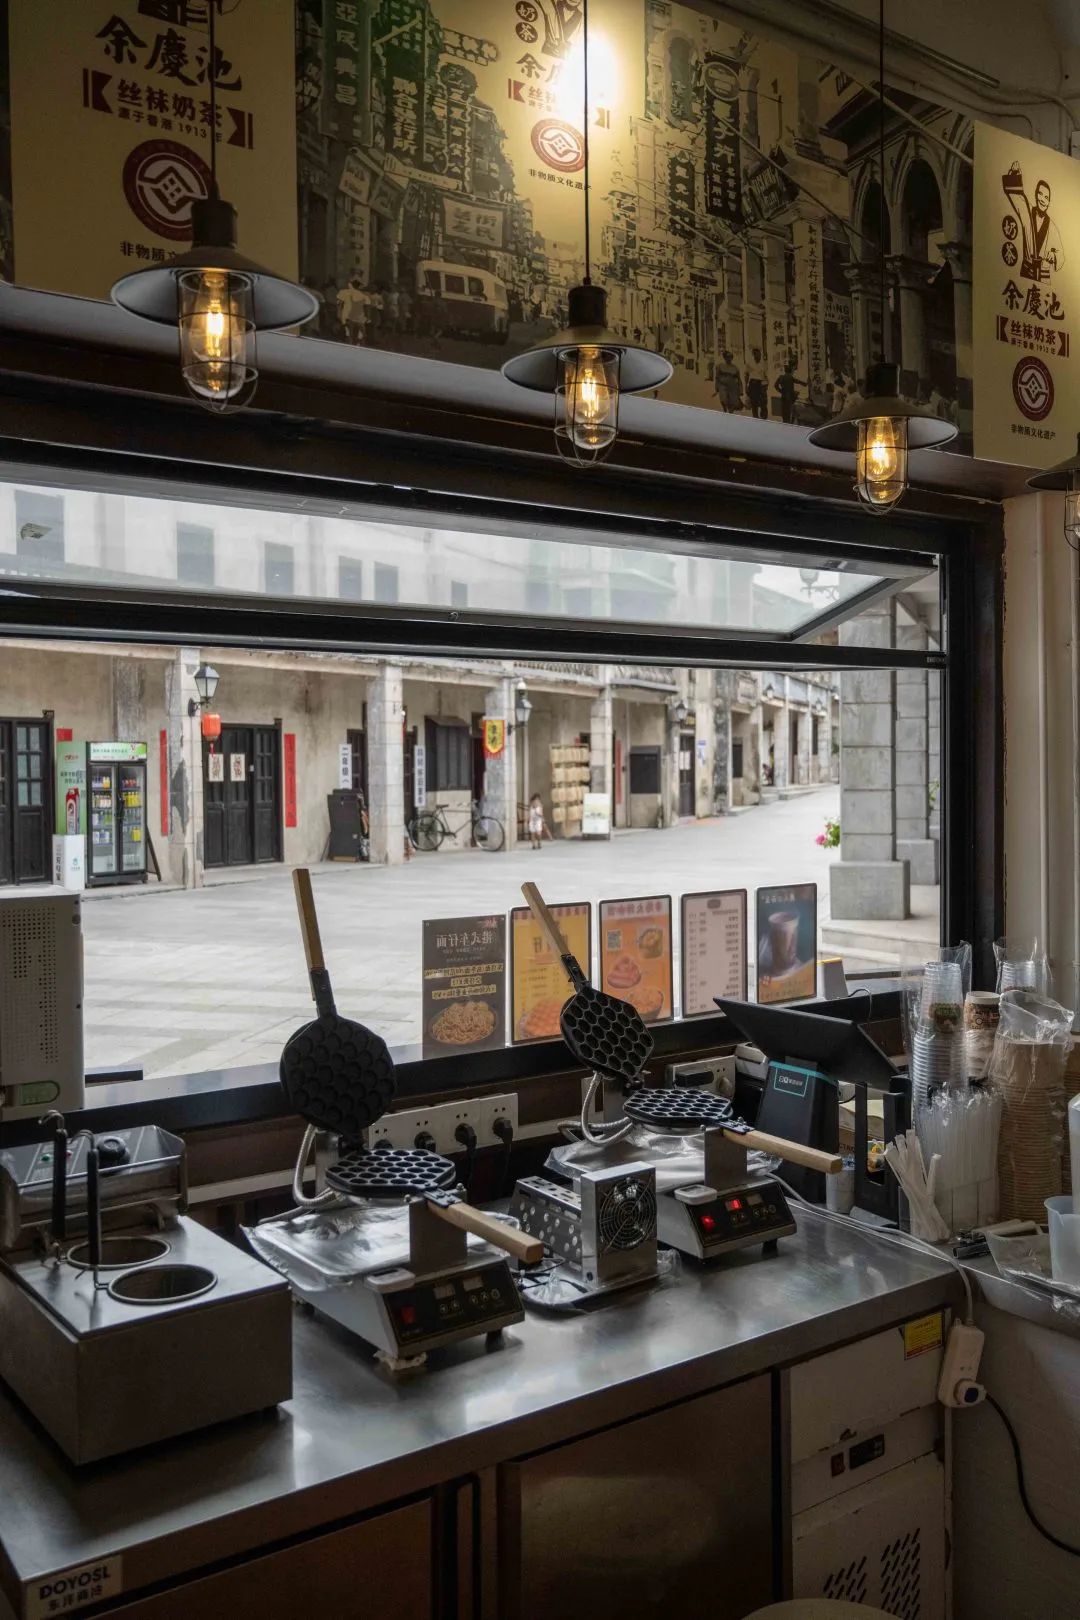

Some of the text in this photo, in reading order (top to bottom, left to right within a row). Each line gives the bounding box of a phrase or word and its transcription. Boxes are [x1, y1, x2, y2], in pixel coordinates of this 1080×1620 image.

[516, 2, 537, 43] 奶茶
[95, 14, 242, 91] 余慶池
[117, 79, 223, 128] 丝袜奶茶
[1002, 217, 1018, 265] 奶茶
[1002, 279, 1065, 321] 余慶池
[1010, 319, 1057, 346] 丝袜奶茶
[40, 1566, 111, 1600] DOYOSL
